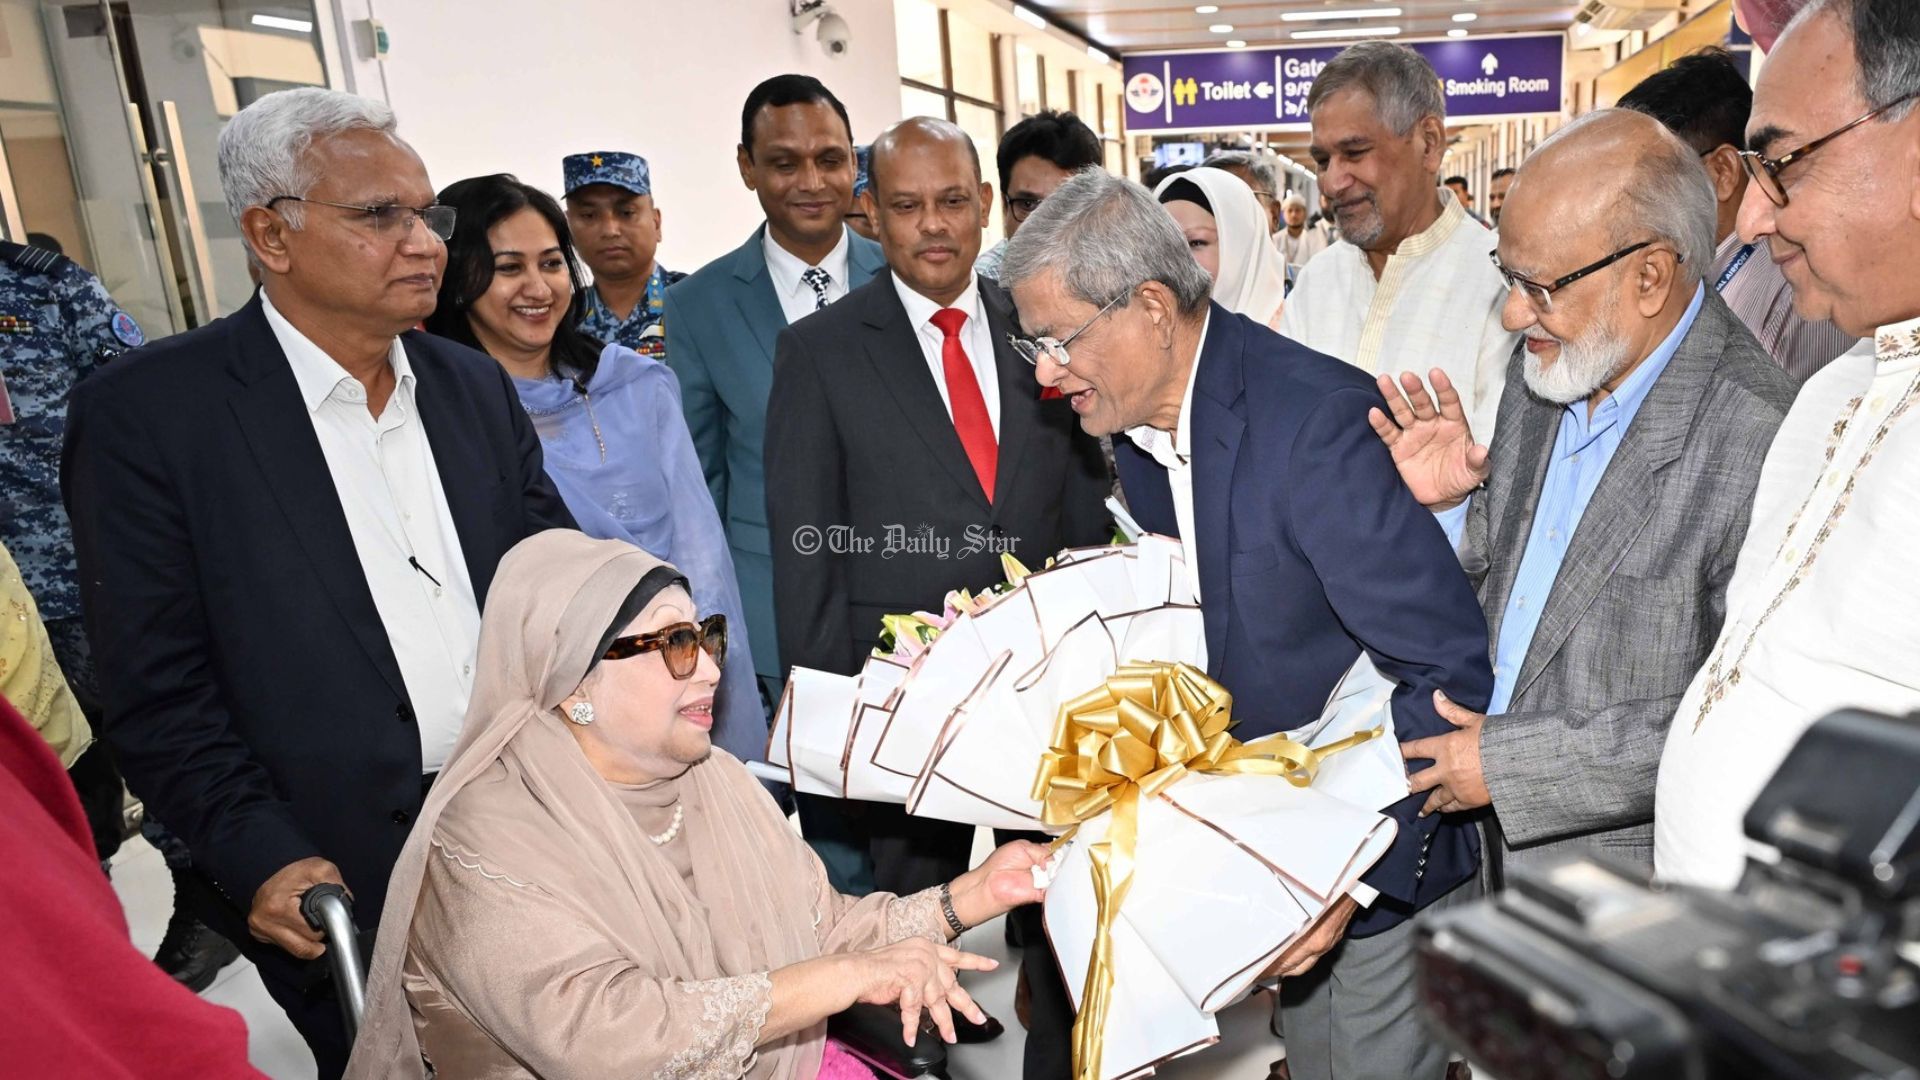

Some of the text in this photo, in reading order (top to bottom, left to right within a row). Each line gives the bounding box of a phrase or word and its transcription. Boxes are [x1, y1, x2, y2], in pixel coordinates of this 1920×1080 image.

[1200, 80, 1252, 101] Toilet
[1446, 76, 1549, 98] Smoking Room
[1725, 251, 1749, 280] AIRPORT
